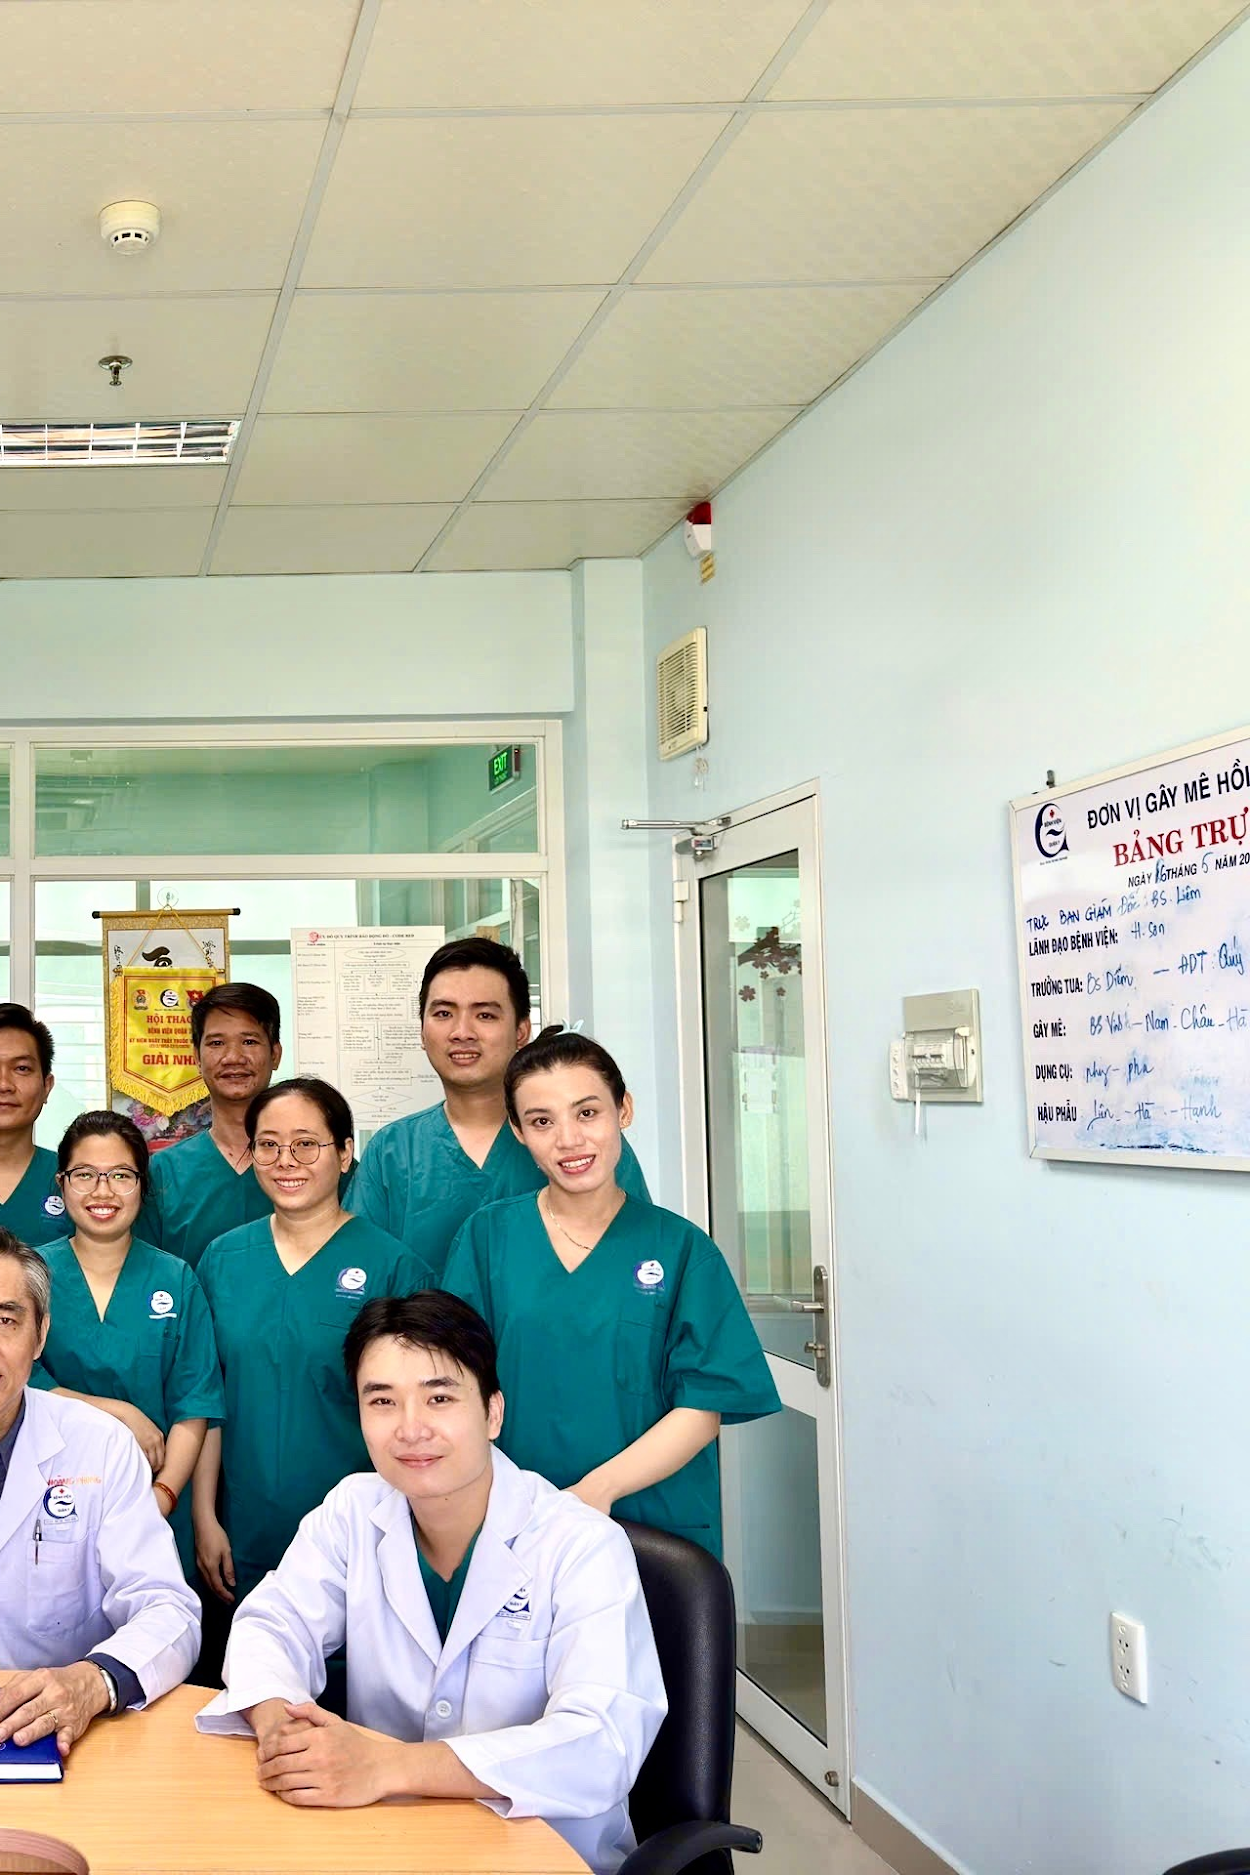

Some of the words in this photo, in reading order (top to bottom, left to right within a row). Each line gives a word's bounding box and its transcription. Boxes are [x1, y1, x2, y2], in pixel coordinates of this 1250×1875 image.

[494, 752, 507, 775] EXIT
[1088, 802, 1120, 828] ĐƠN
[1125, 796, 1140, 820] VỊ
[1146, 784, 1178, 813] GÂY
[1184, 772, 1210, 803] MÊ
[1217, 759, 1250, 794] HỒI
[1113, 829, 1184, 866] BẢNG
[1191, 806, 1249, 849] TRỰ
[1128, 872, 1152, 887] NGÀY
[1166, 863, 1197, 880] THÁNG
[1215, 855, 1236, 870] NĂM
[1059, 910, 1080, 925] BAN
[1029, 938, 1049, 956] LÃNH
[1052, 938, 1068, 955] ĐẠO
[1071, 931, 1093, 952] BỆNH
[1096, 926, 1118, 948] VIỆN:
[1032, 976, 1062, 996] TRƯỞNG
[1065, 978, 1082, 994] TUA:
[147, 1014, 163, 1025] HỘI
[1033, 1020, 1048, 1038] GÂY
[1051, 1018, 1066, 1036] MÊ:
[142, 1052, 168, 1065] GIẢI
[173, 1055, 196, 1065] NH
[1036, 1064, 1057, 1082] DỤNG
[1059, 1064, 1072, 1082] CỤ:
[1038, 1102, 1054, 1124] HẬU
[1056, 1099, 1077, 1122] PHẪU
